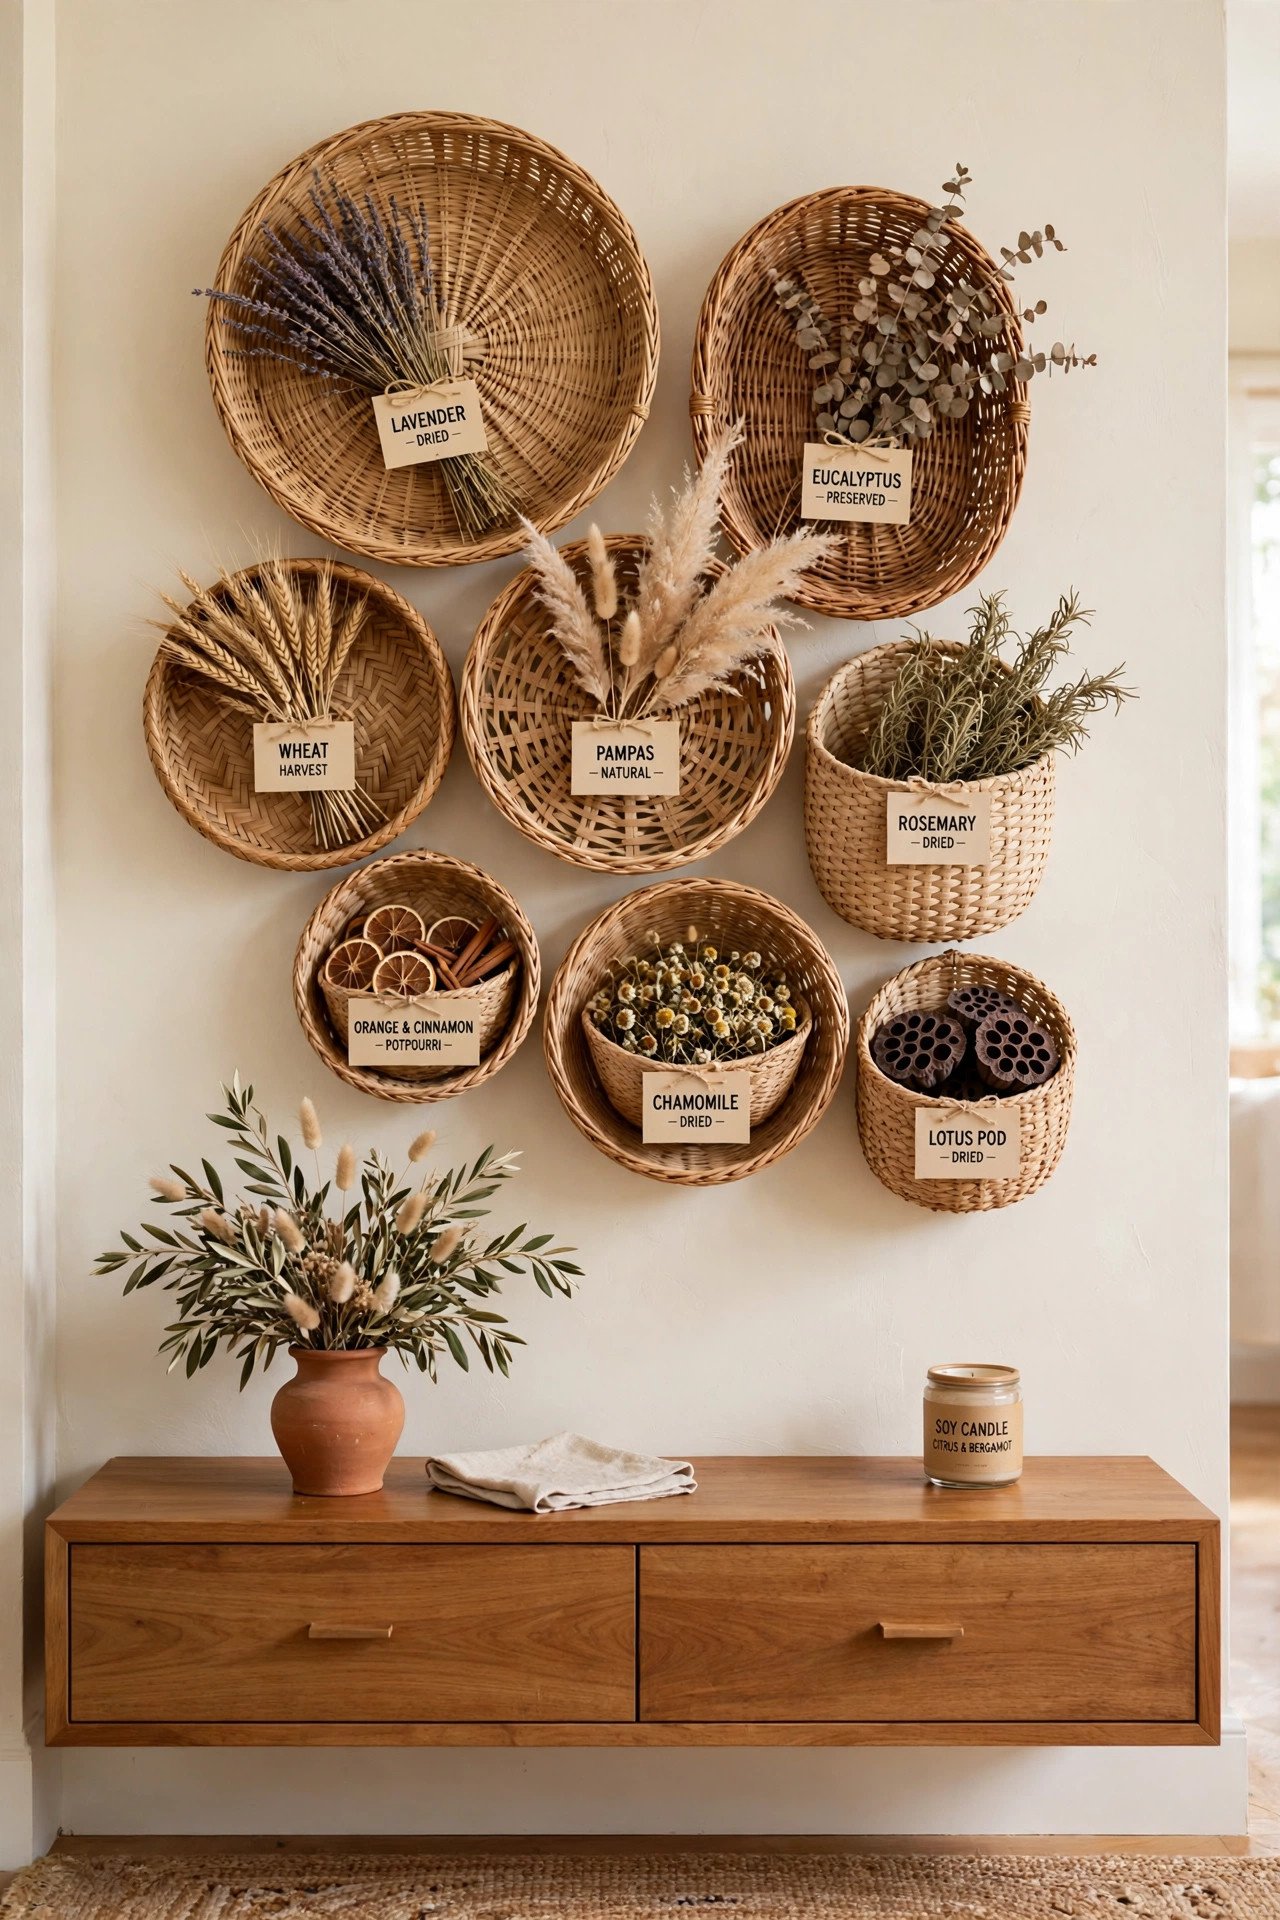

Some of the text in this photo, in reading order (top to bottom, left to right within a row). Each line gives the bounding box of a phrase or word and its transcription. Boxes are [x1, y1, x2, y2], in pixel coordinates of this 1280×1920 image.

[391, 405, 467, 433] LAVENDER
[417, 430, 449, 446] DRIED
[813, 469, 901, 488] EUCALYPTUS
[827, 491, 885, 505] PRESERVED
[279, 743, 328, 758] WHEAT
[597, 745, 654, 761] PAMPAS
[280, 764, 327, 776] HARVEST
[602, 767, 651, 778] NATURAL
[899, 816, 976, 831] ROSEMARY
[923, 837, 954, 848] DRIED
[354, 1021, 473, 1034] ORANGE & CINNAMON
[386, 1039, 441, 1050] POTPOURRI
[653, 1095, 738, 1110] CHAMOMILE
[681, 1116, 712, 1127] DRIED
[930, 1130, 1006, 1145] LOTUS POD
[952, 1151, 983, 1162] DRIED
[936, 1419, 1008, 1436] SOY CANDLE
[933, 1439, 1012, 1453] CITRUS & BERGAMOT
